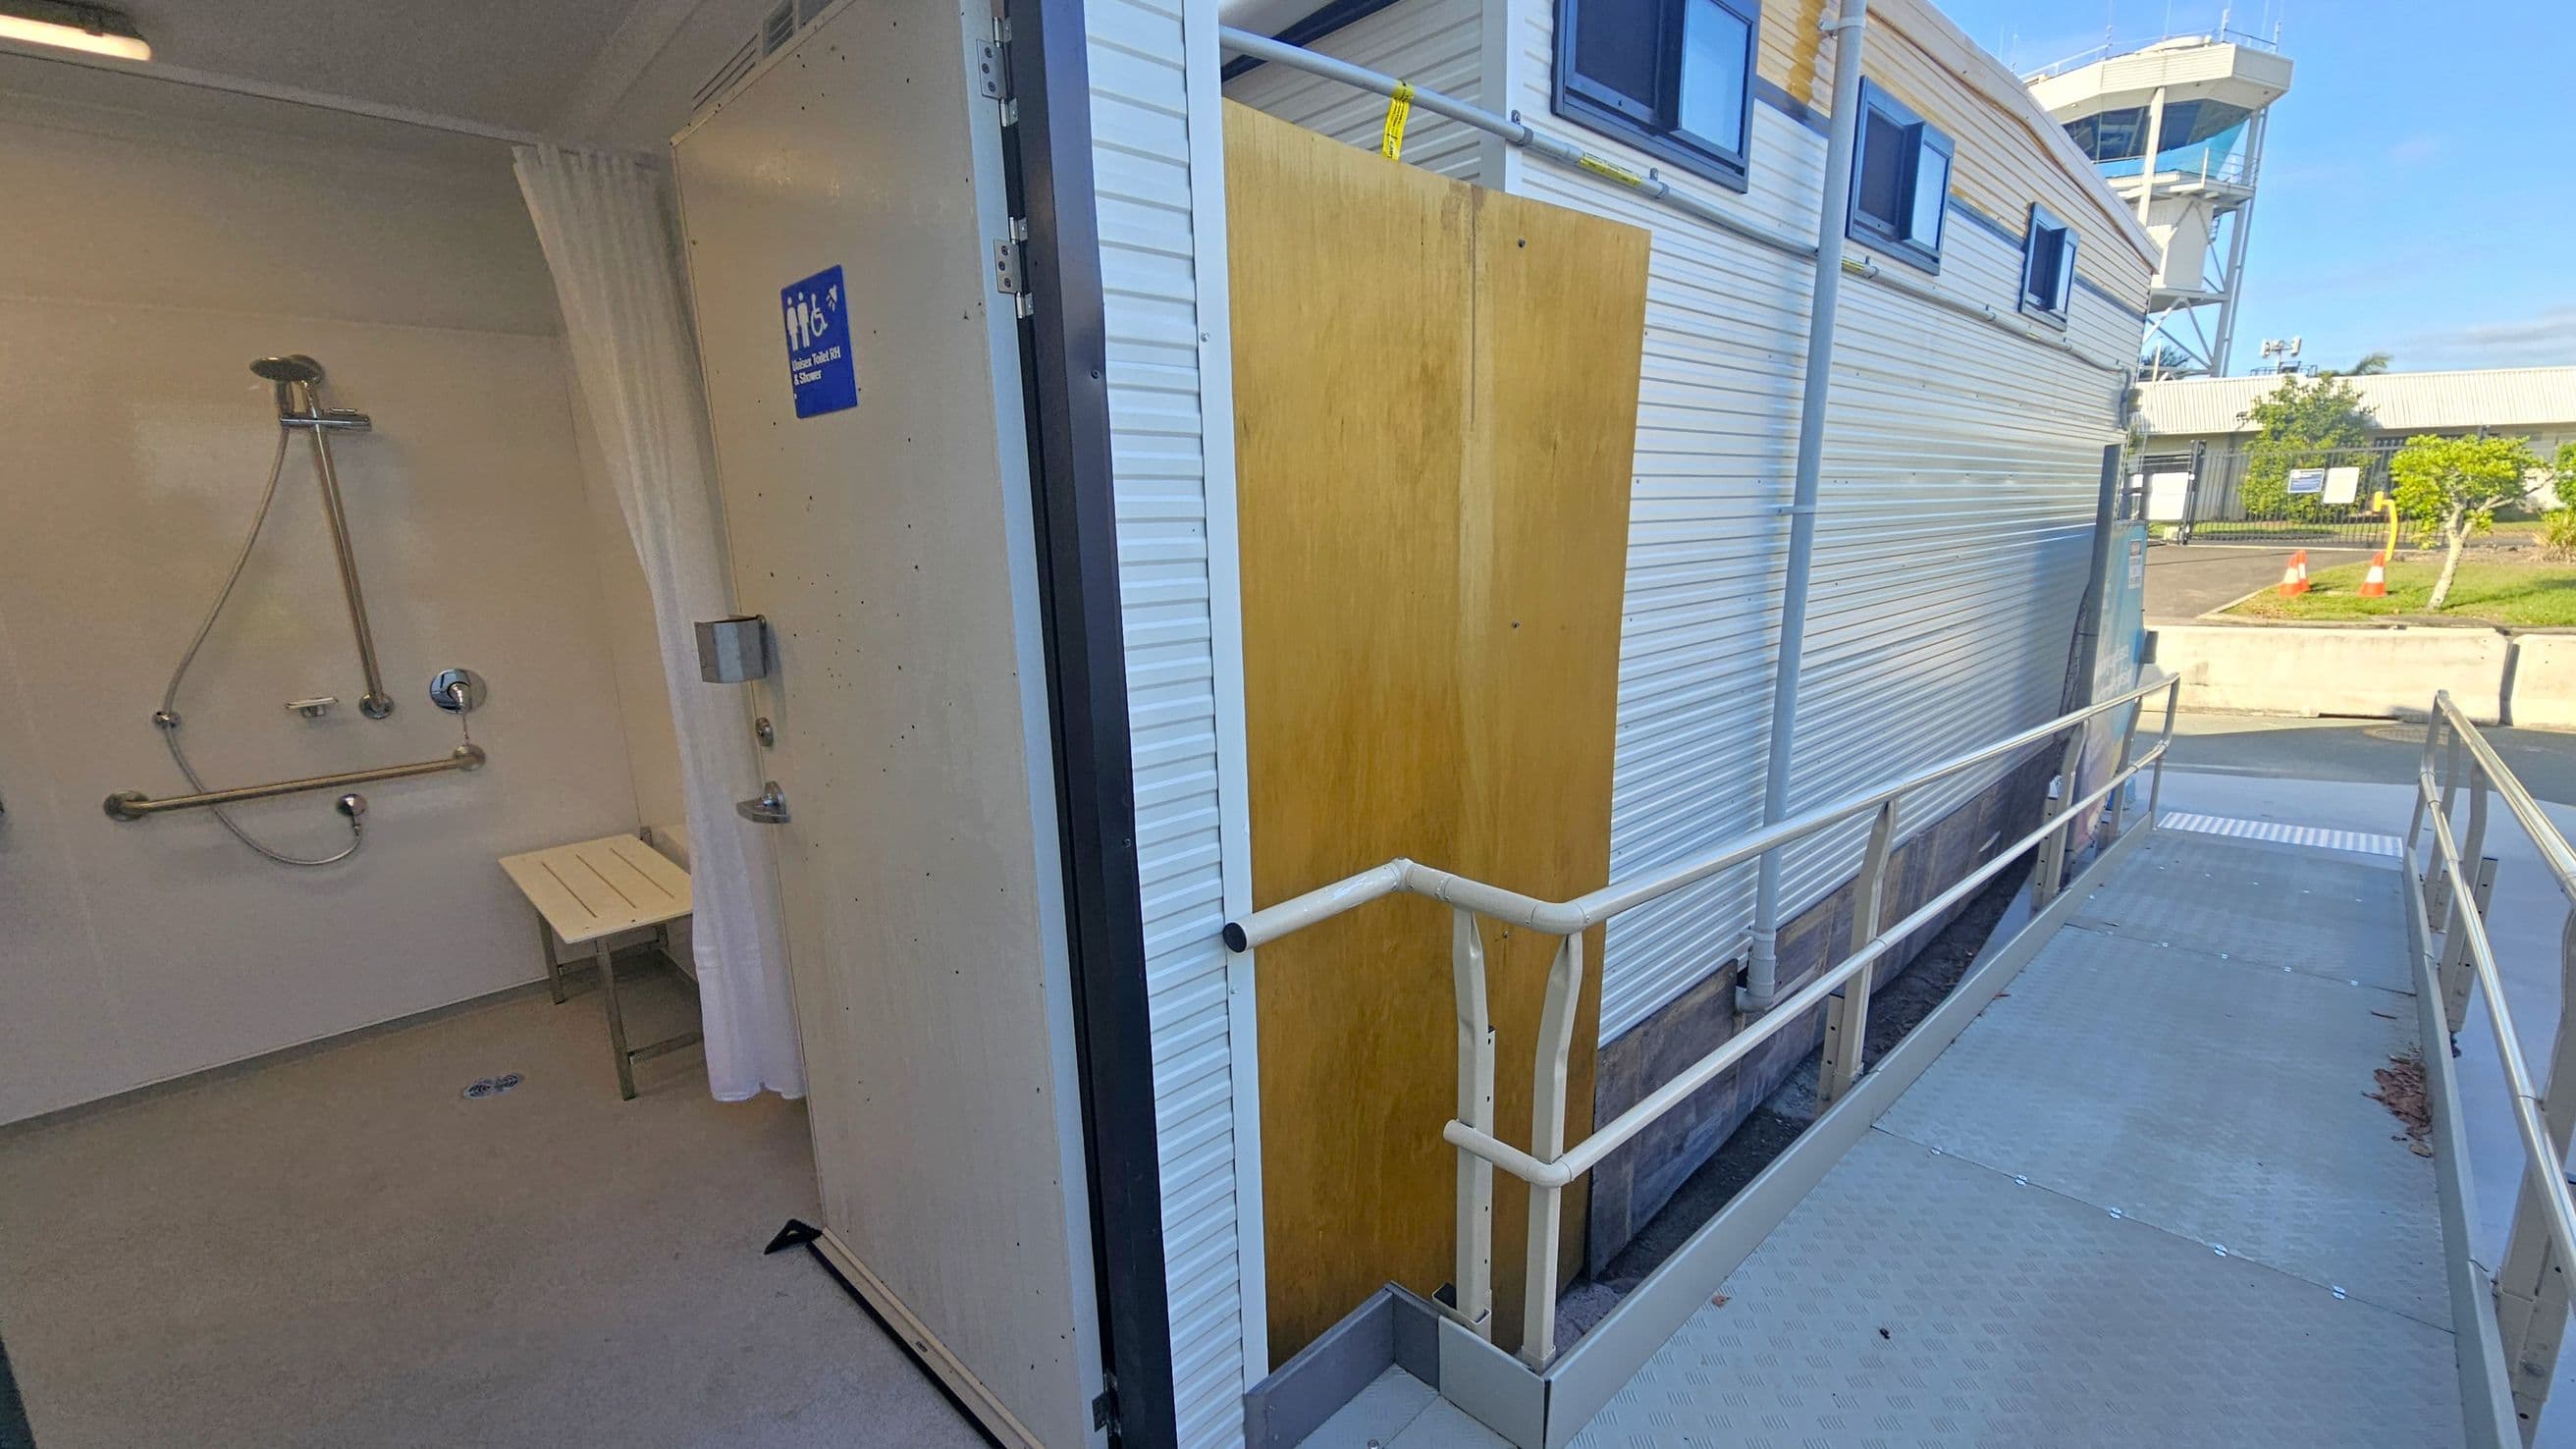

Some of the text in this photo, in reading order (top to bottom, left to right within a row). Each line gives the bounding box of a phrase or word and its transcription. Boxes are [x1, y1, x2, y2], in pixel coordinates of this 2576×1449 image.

[792, 346, 841, 371] Unisex Toilet RH
[794, 370, 822, 386] & Shower
